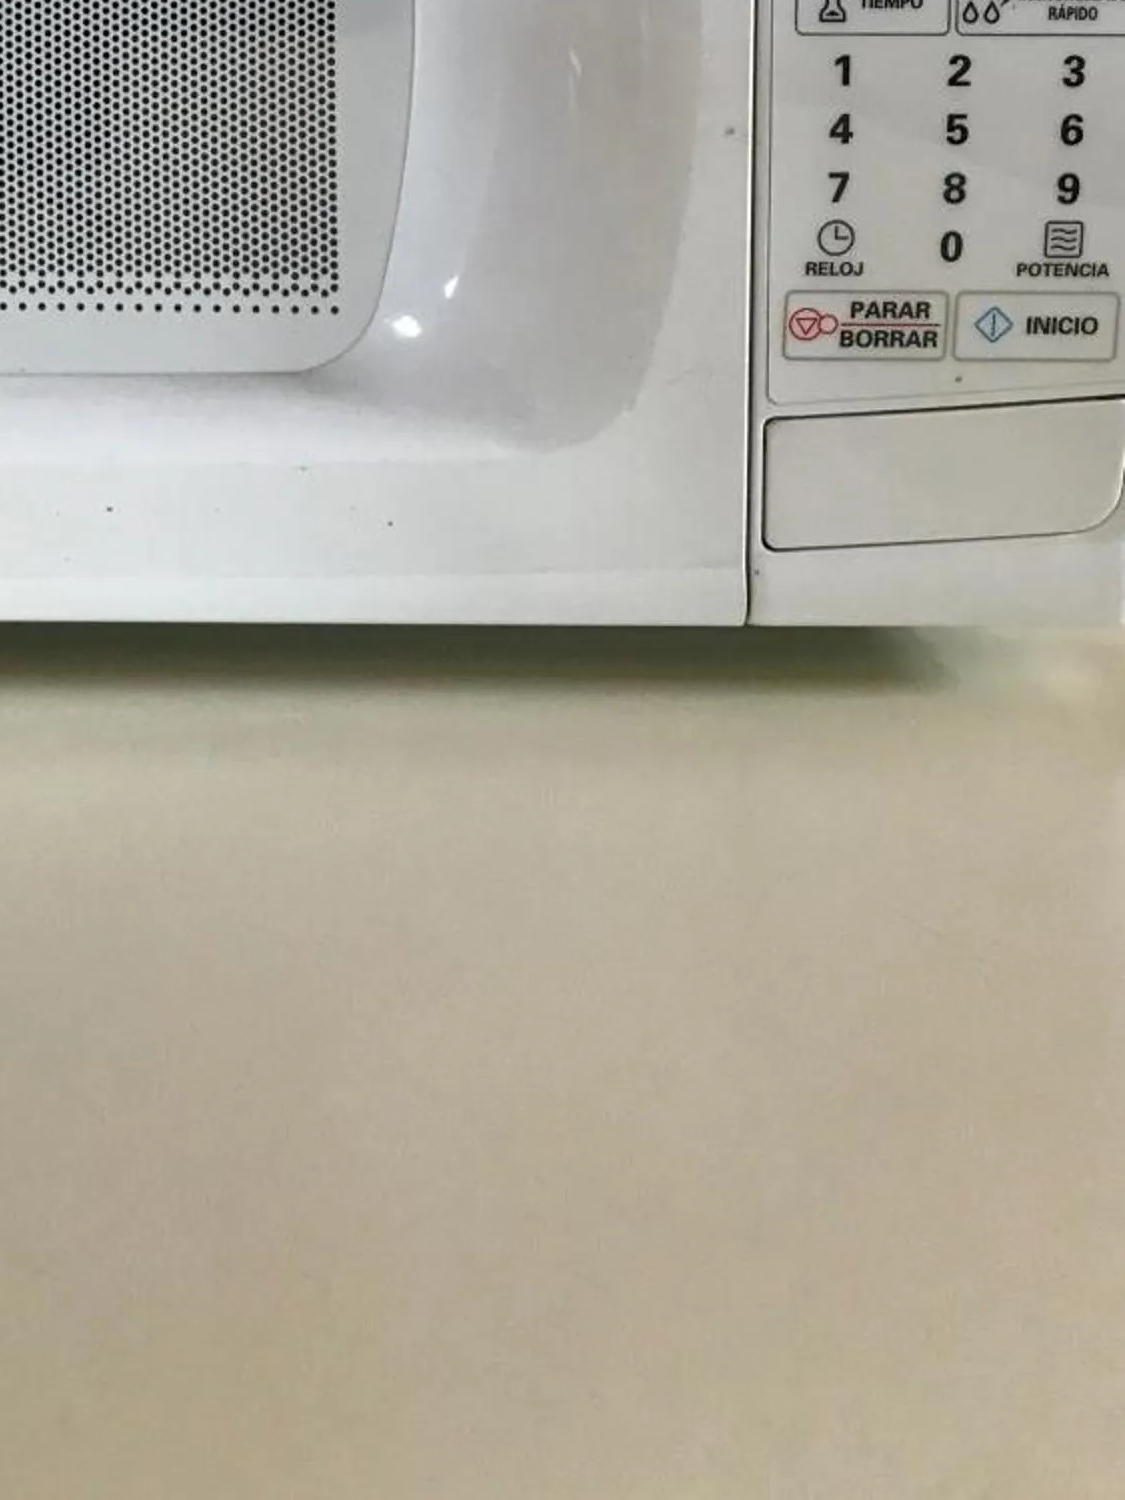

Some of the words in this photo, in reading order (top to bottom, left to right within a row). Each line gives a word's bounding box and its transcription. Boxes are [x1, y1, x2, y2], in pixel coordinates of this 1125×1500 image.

[1048, 4, 1098, 20] RÁPIDO
[834, 55, 851, 86] 1
[948, 55, 971, 87] 2
[1062, 55, 1085, 87] 3
[829, 114, 854, 144] 4
[946, 114, 969, 145] 5
[1060, 114, 1084, 146] 6
[828, 172, 850, 203] 7
[943, 172, 967, 203] 8
[1057, 174, 1080, 204] 9
[940, 231, 963, 263] 0
[805, 262, 864, 276] RELOJ
[1016, 263, 1110, 277] POTENCIA
[850, 301, 931, 319] PARAR
[839, 330, 938, 349] BORRAR
[1026, 317, 1099, 335] INICIO
